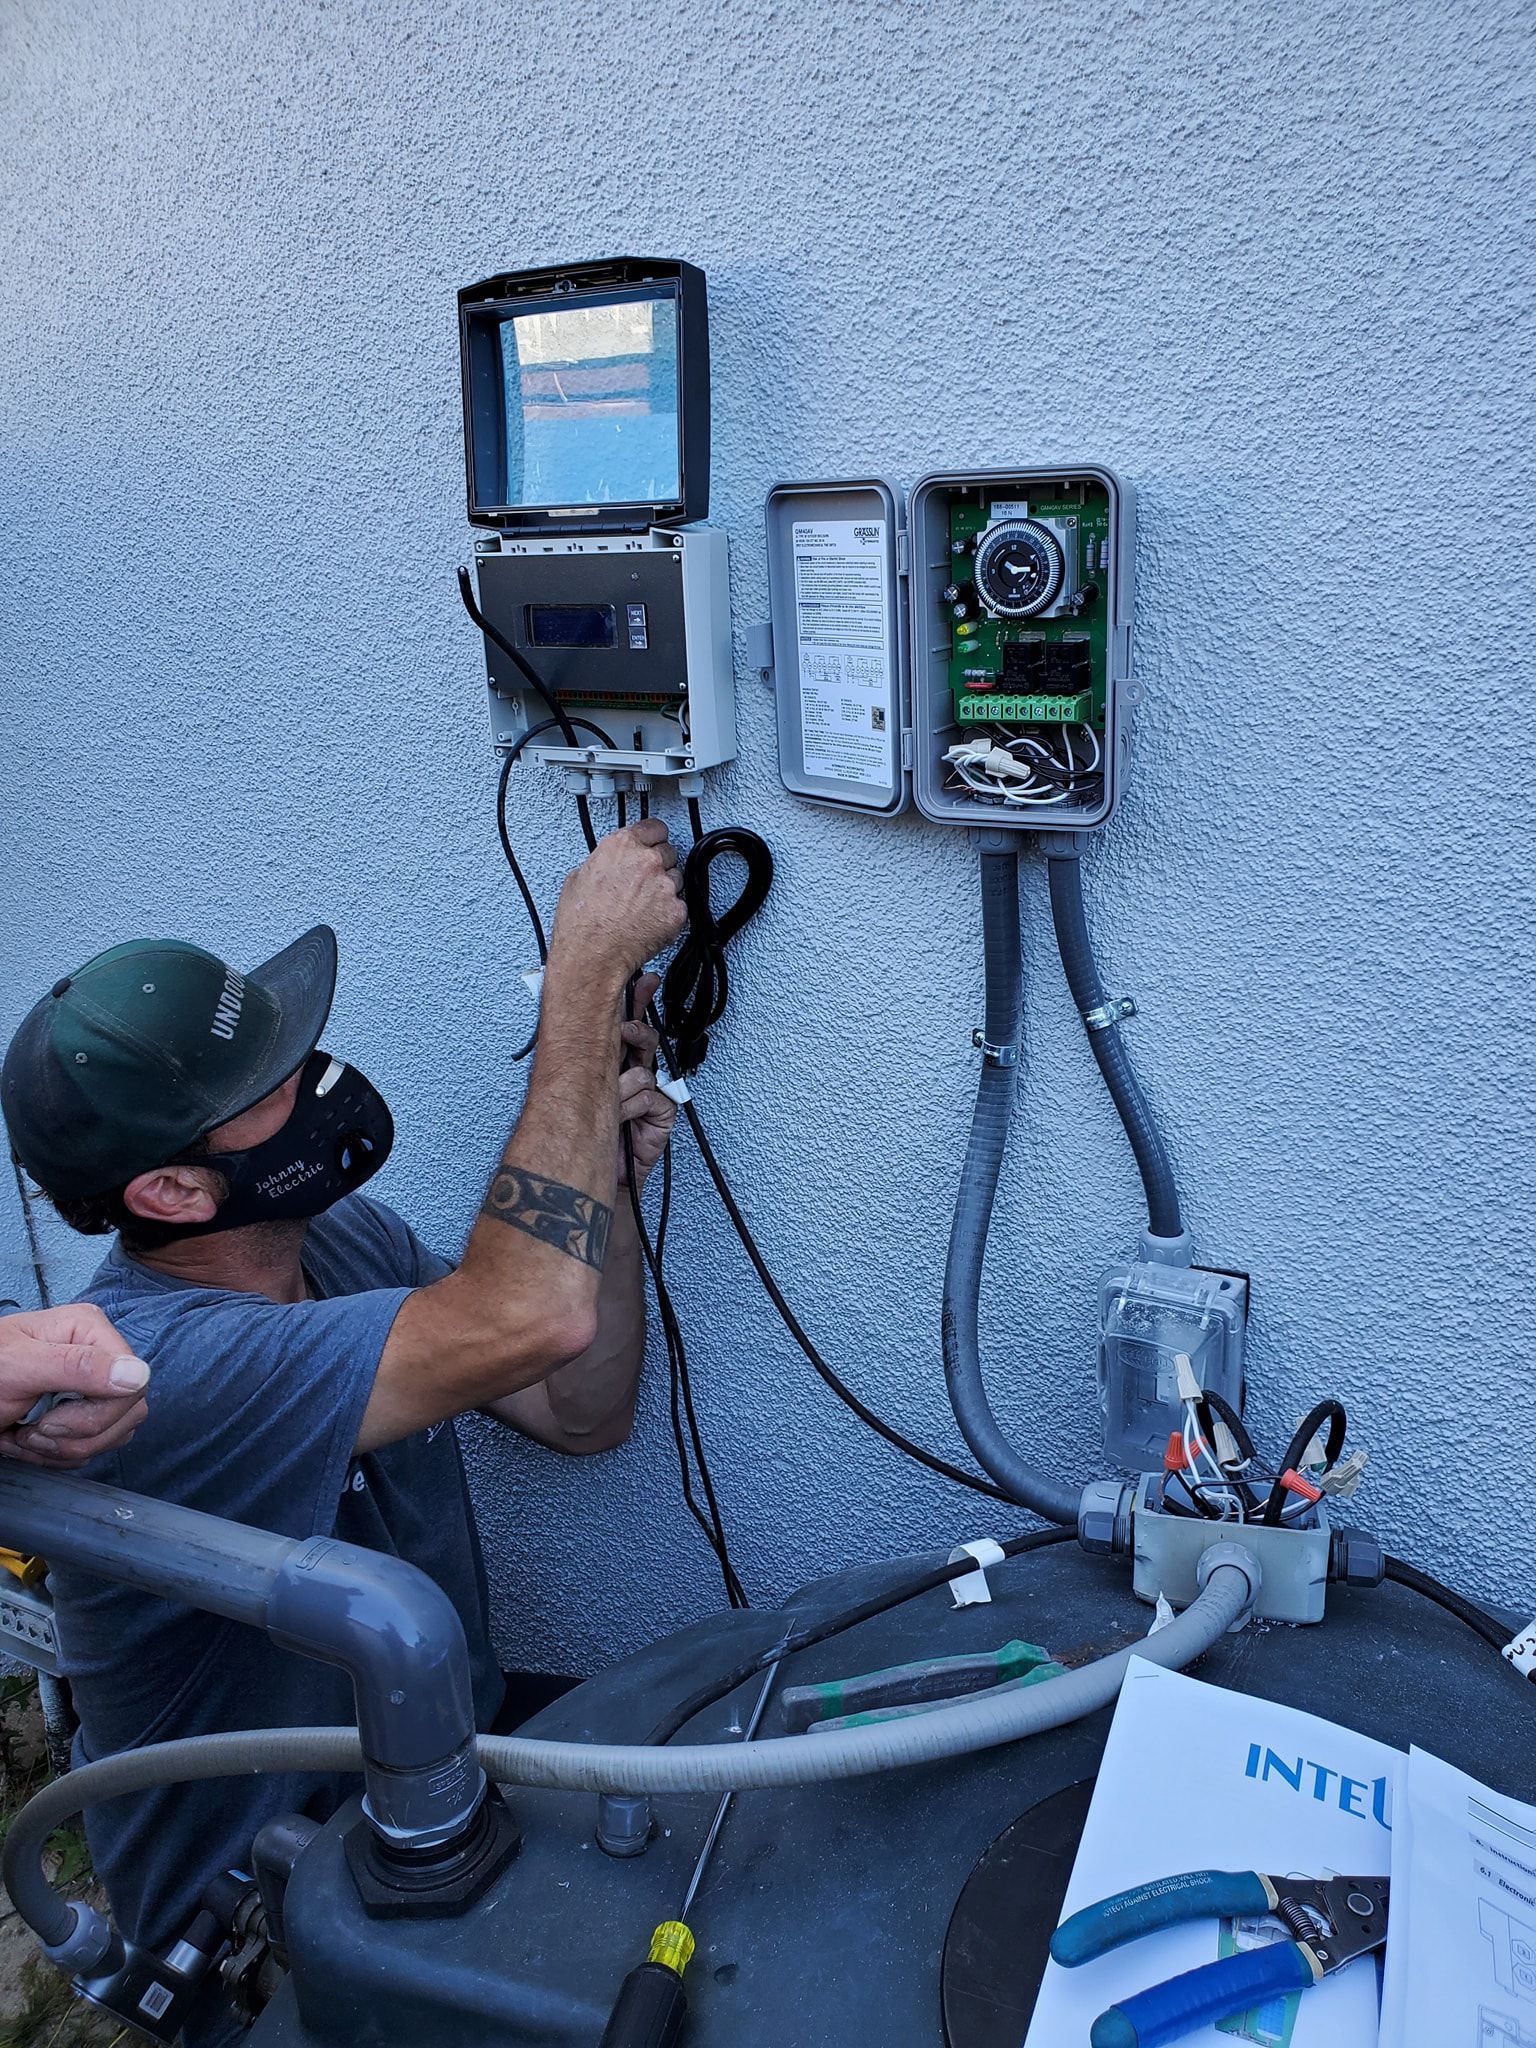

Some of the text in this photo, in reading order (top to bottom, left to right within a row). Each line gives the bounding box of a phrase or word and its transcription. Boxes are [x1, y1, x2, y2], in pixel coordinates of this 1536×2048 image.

[255, 1159, 305, 1194] Johnny
[268, 1162, 325, 1199] Electric
[1124, 1891, 1152, 1907] AGAINST
[1151, 1881, 1190, 1897] ELECTRICAL
[1480, 1866, 1536, 1907] 6.1 Electronic
